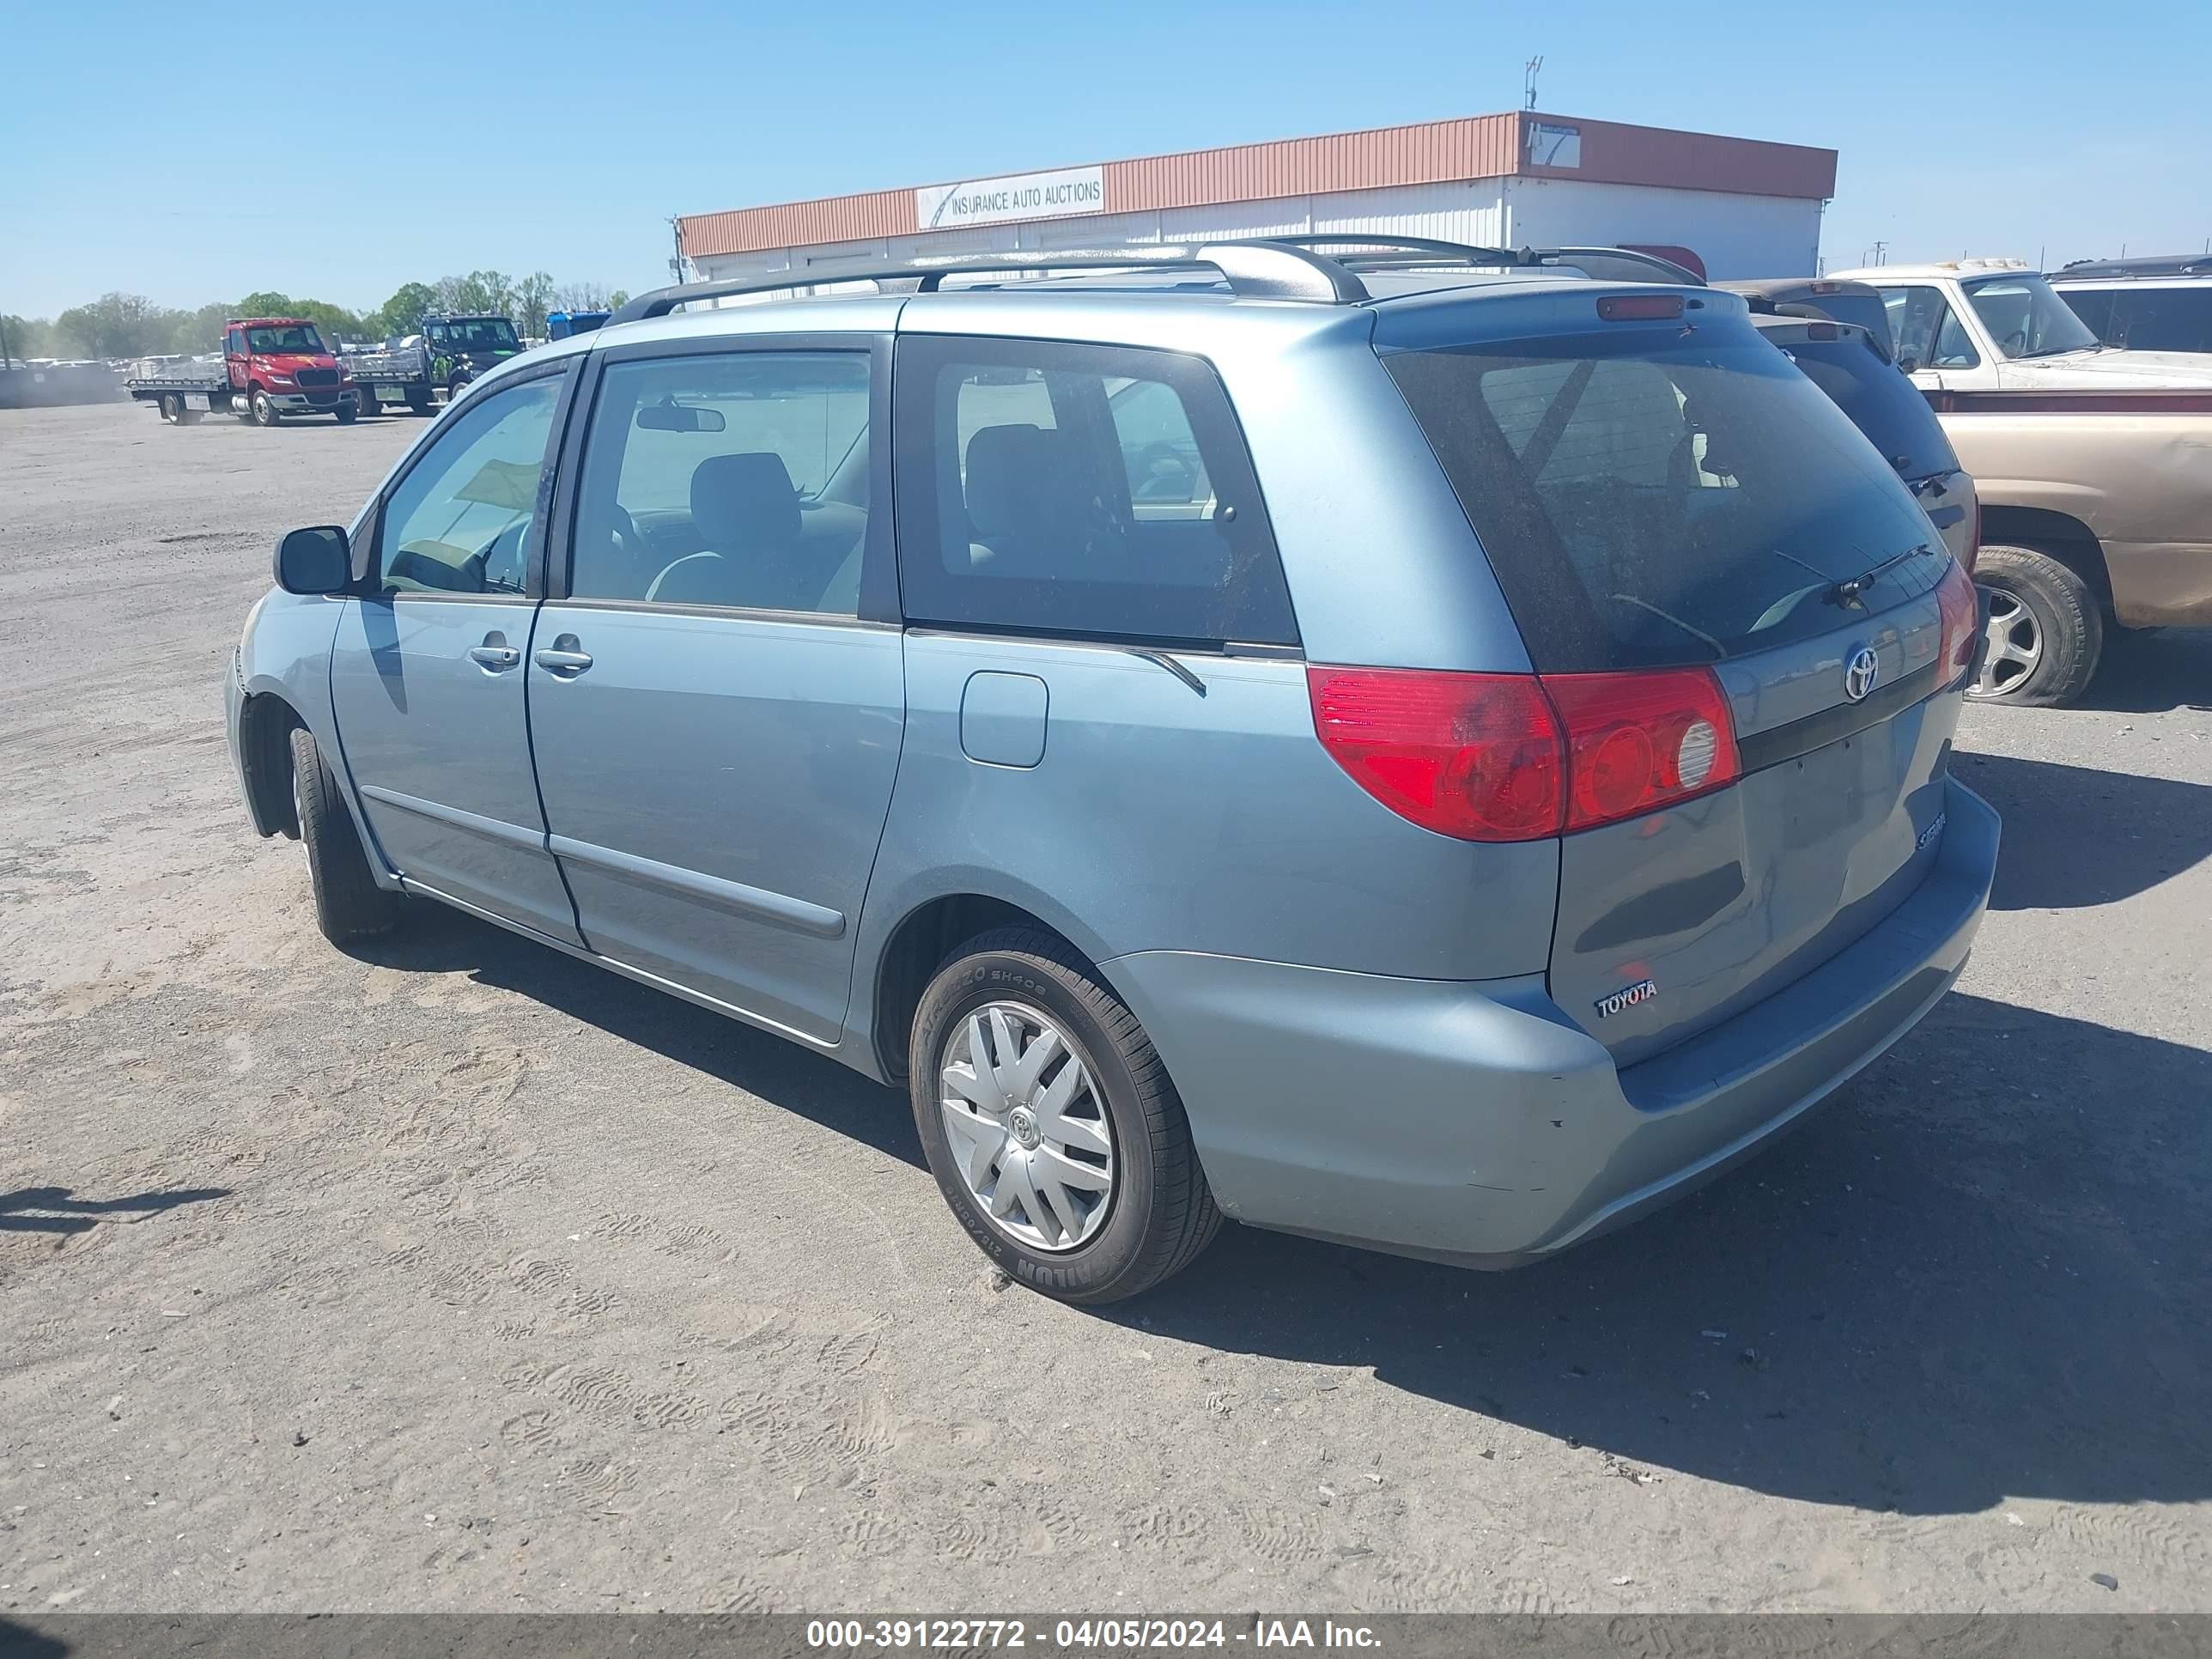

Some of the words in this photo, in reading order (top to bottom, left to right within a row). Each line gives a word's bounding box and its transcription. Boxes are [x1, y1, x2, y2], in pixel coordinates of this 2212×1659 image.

[952, 192, 1008, 215] INSURANCE
[1013, 188, 1040, 208] AUTO
[1045, 181, 1100, 204] AUCTIONS
[1595, 980, 1658, 1018] TOYOTA
